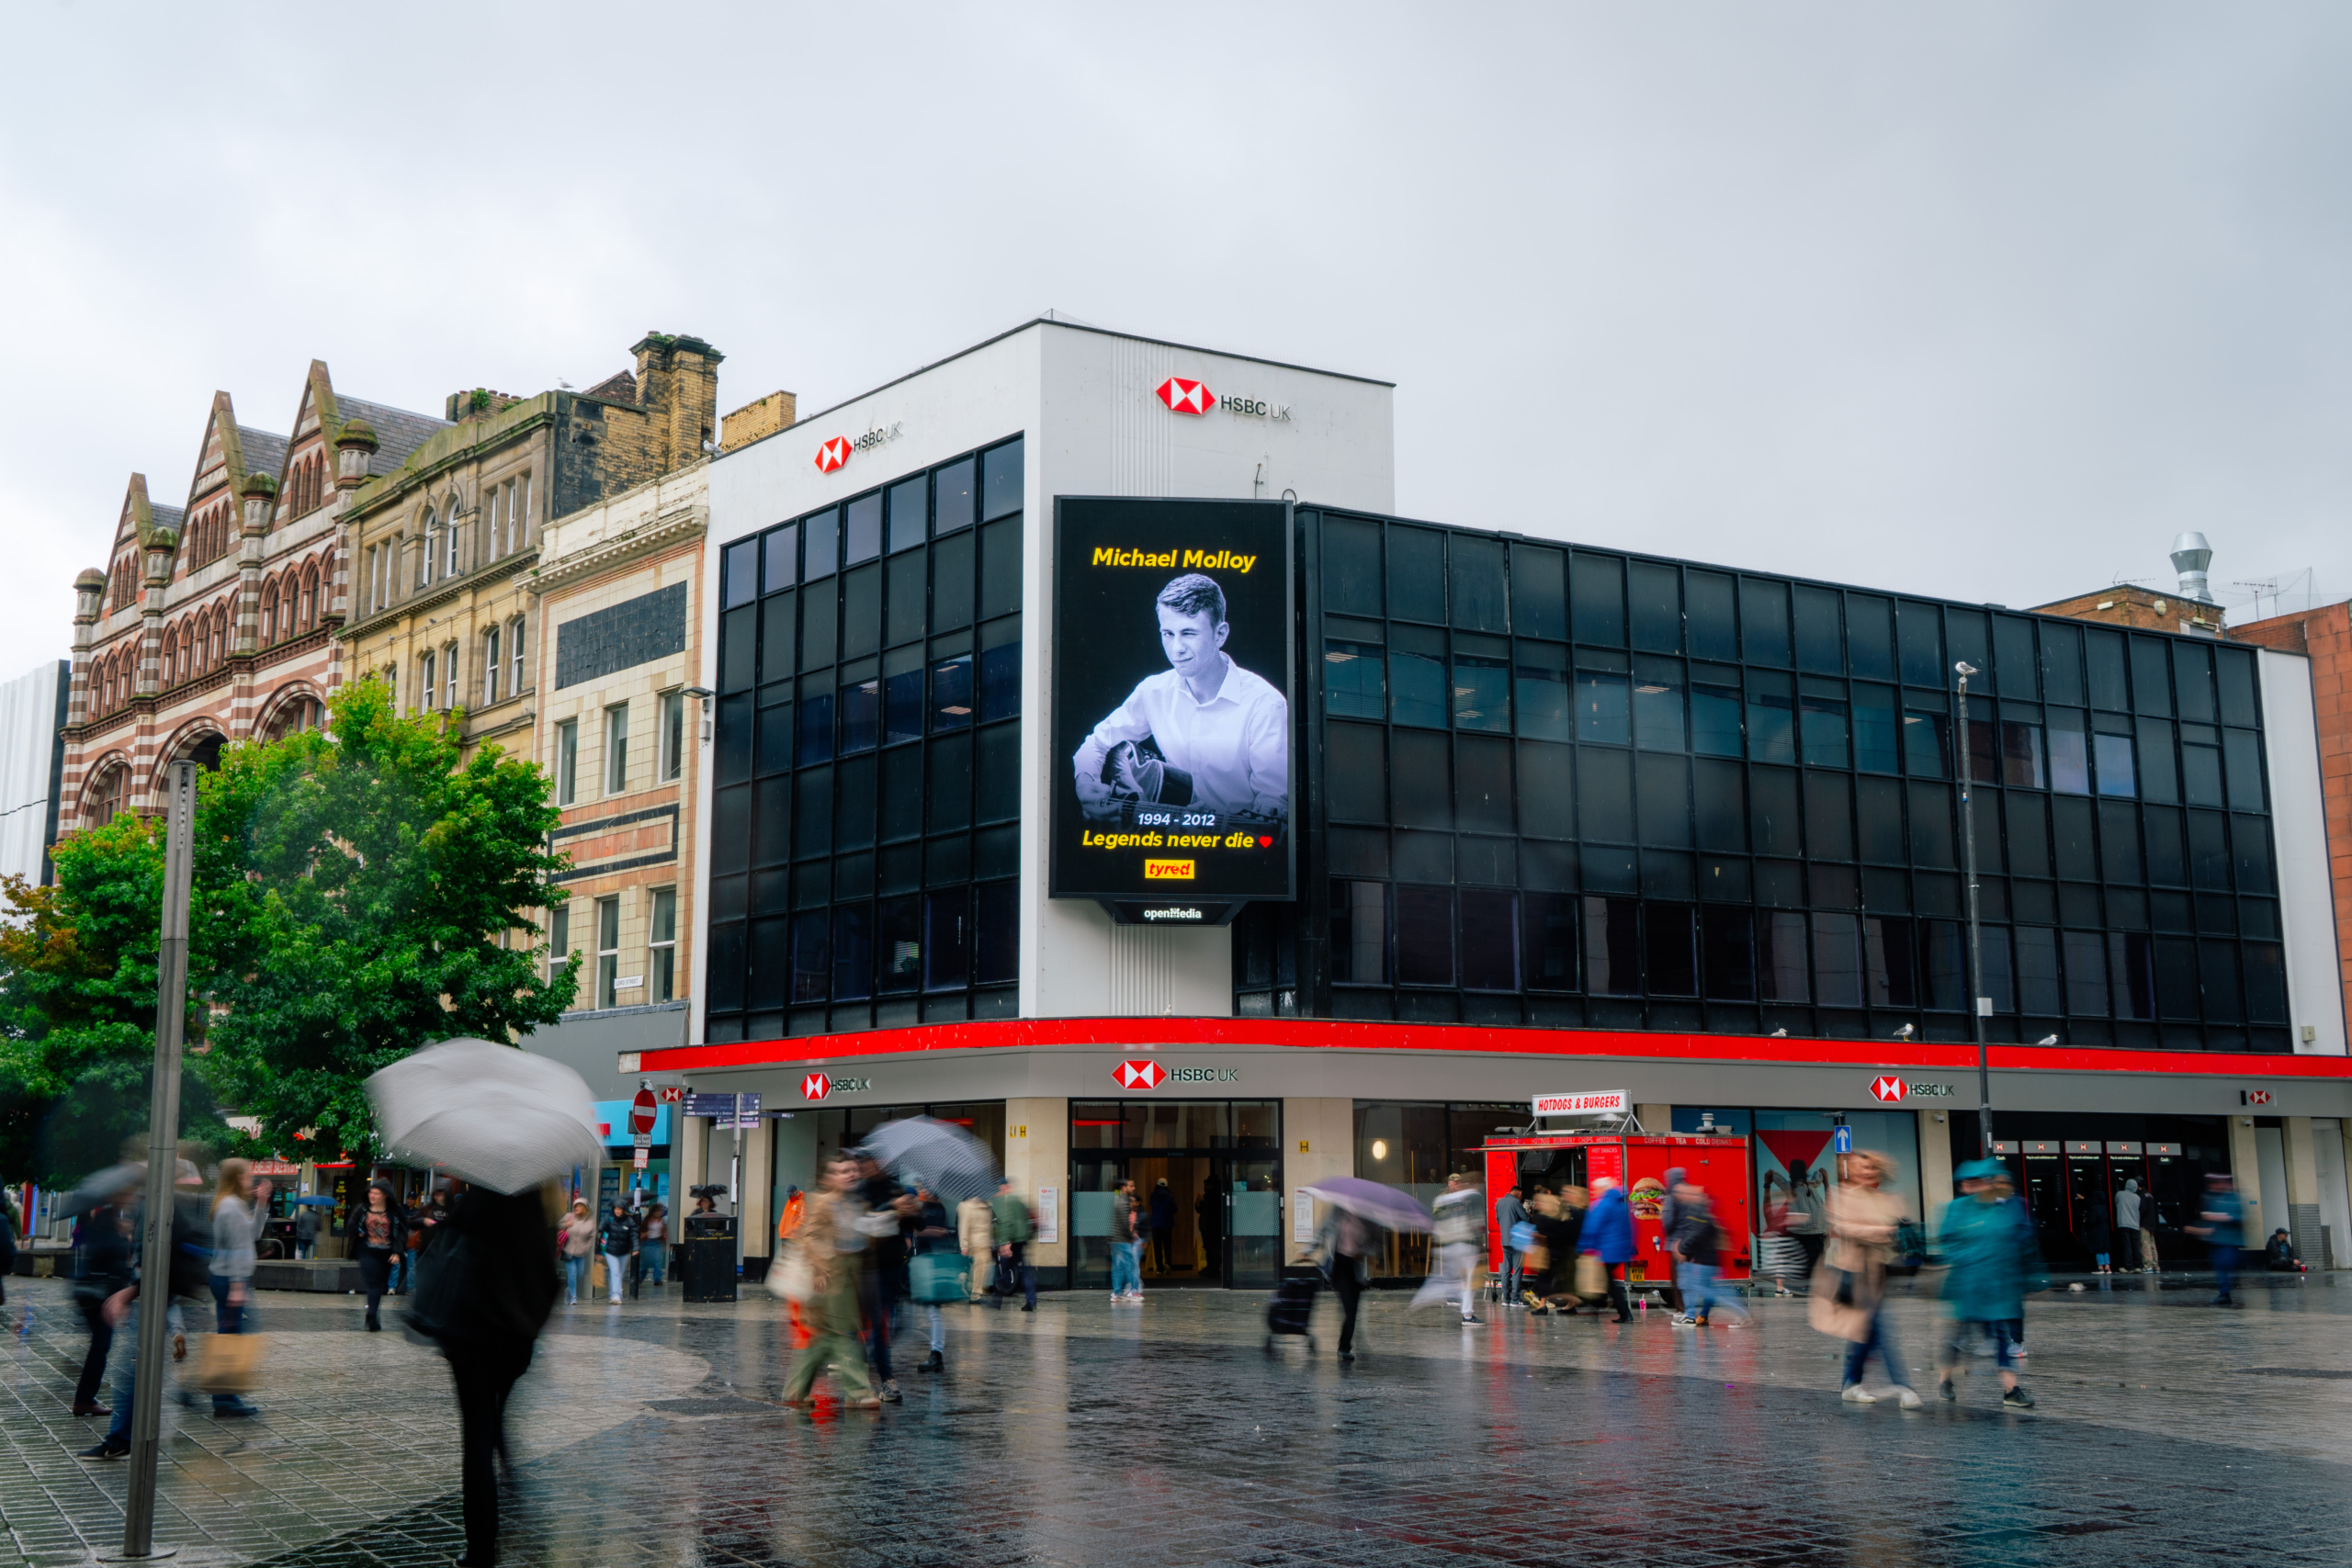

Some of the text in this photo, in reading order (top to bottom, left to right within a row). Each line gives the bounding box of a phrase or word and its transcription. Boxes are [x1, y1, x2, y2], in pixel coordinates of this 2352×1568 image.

[1221, 395, 1291, 420] HSBC UK
[853, 421, 903, 451] HSBC UK
[1093, 548, 1256, 573] Michael Molloy
[1137, 814, 1170, 825] 1994
[1183, 814, 1215, 826] 2012
[1083, 830, 1254, 849] Legends never die
[1149, 863, 1190, 877] tyred
[1144, 908, 1202, 920] openMedia
[1170, 1069, 1238, 1082] HSBC UK
[831, 1077, 871, 1092] HSBC UK
[1910, 1083, 1955, 1097] HSBC UK
[1538, 1095, 1620, 1111] HOTDOGS & BURGERS
